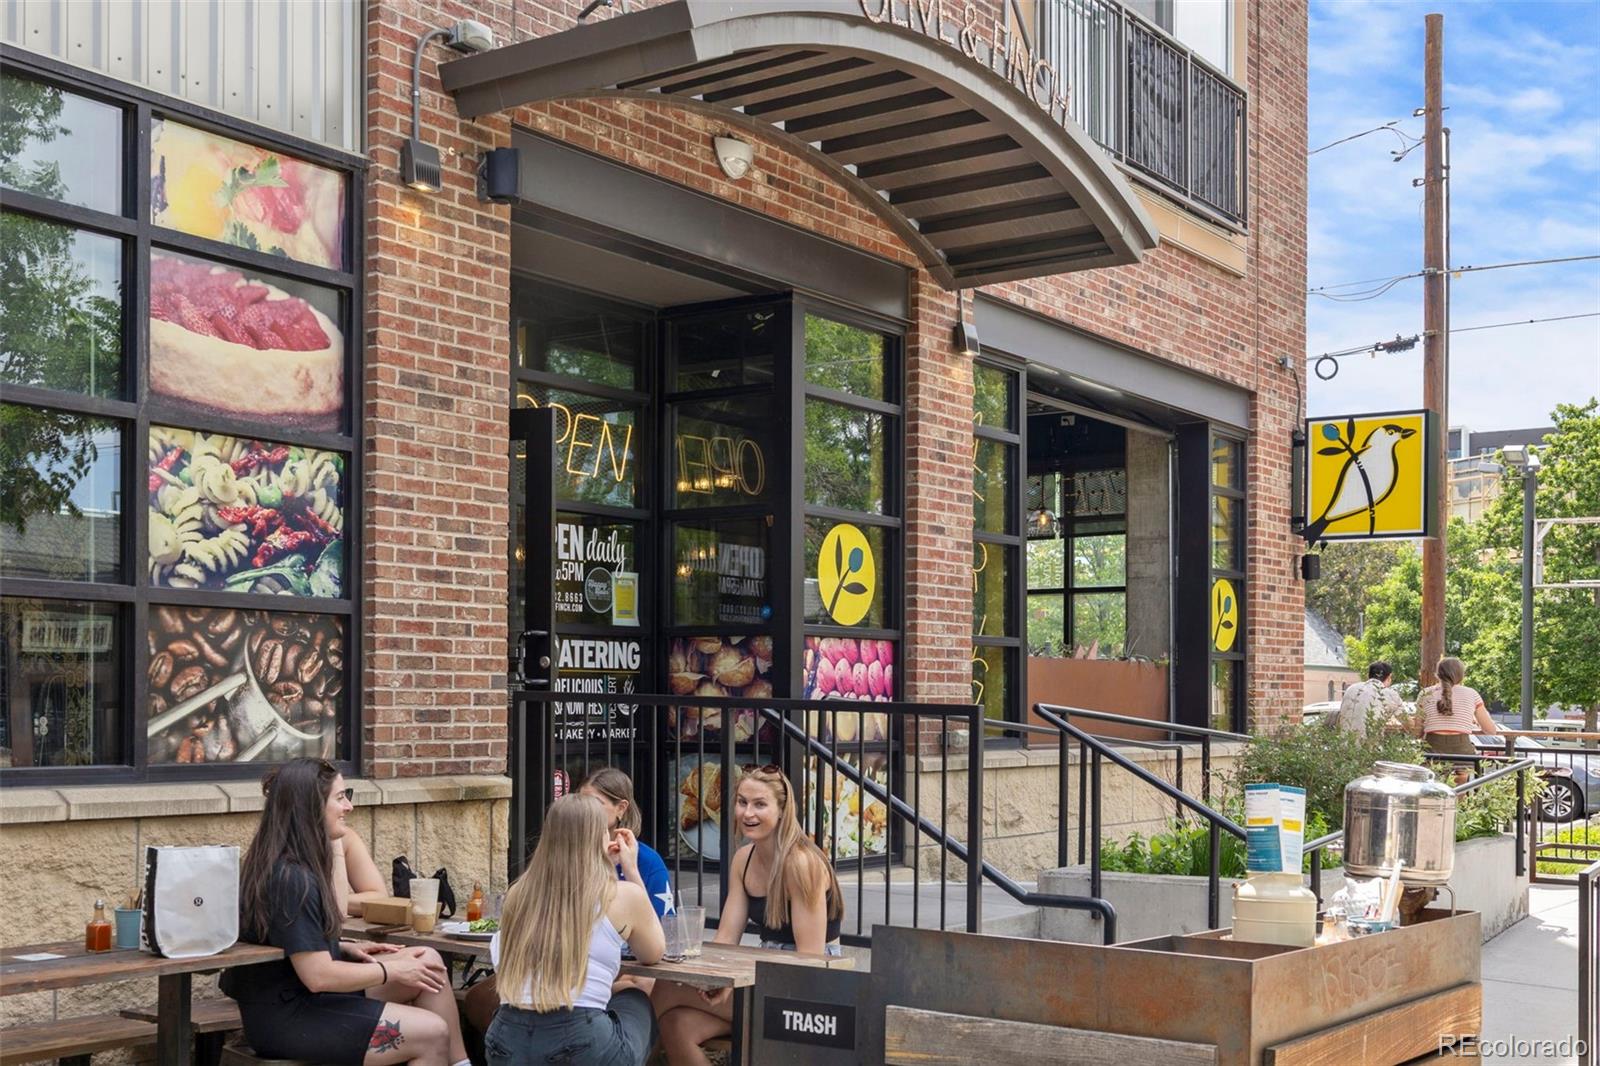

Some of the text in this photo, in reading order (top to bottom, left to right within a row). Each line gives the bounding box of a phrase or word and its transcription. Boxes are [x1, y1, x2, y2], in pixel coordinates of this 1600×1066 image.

[991, 18, 1072, 128] FINCH
[516, 394, 632, 482] PEN
[555, 522, 626, 578] EN daily
[562, 561, 584, 582] 5PM
[782, 1010, 837, 1036] TRASH
